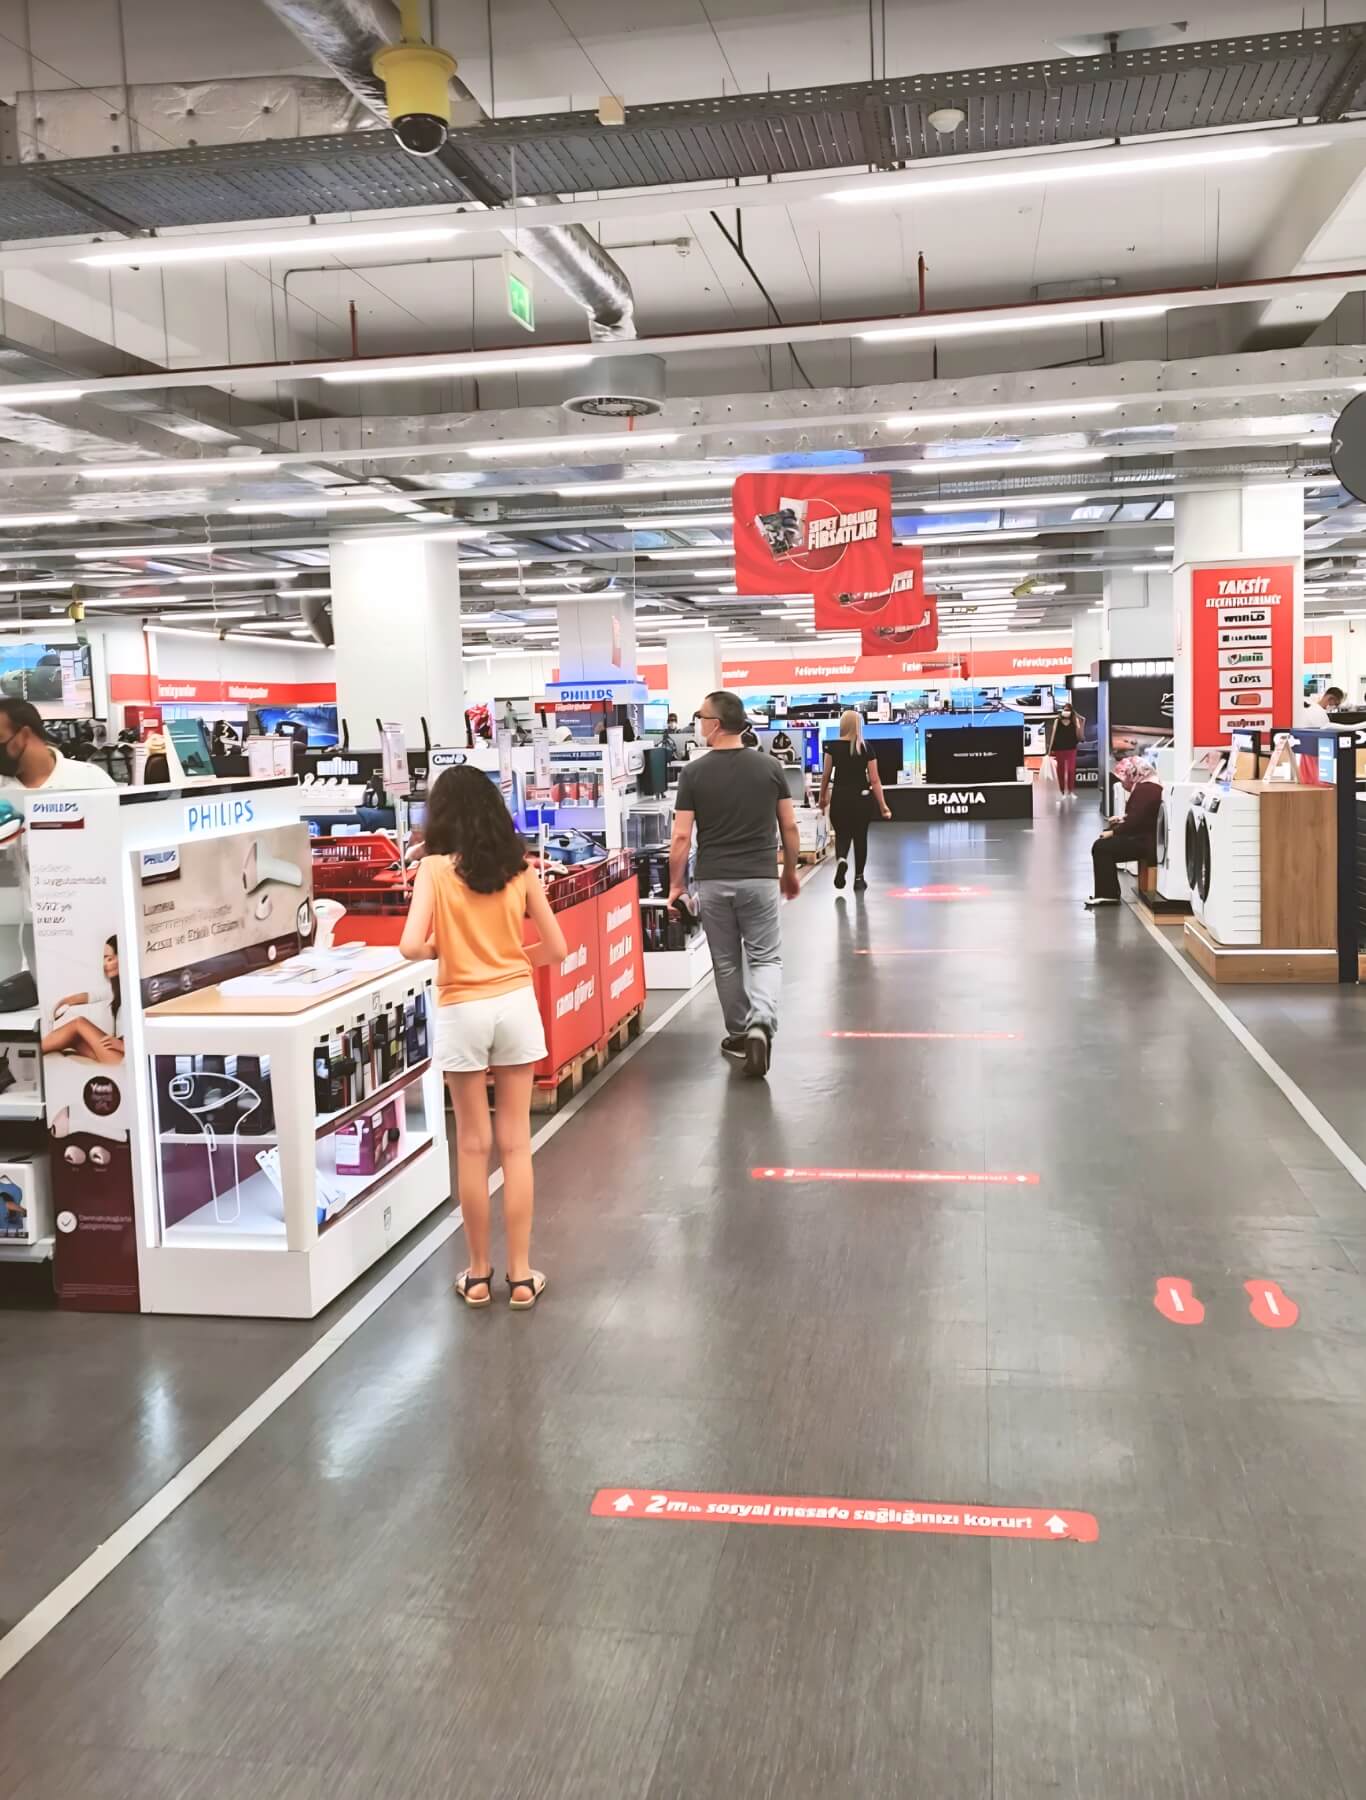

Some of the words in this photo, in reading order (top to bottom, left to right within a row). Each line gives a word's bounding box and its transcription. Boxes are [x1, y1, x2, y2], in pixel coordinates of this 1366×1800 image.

[808, 521, 877, 550] FIRSATLAR
[1218, 576, 1271, 595] TAKSİT
[1111, 661, 1174, 677] SAMSUN
[561, 689, 613, 701] PHILIPS
[928, 791, 986, 805] BRAVIA
[188, 800, 254, 832] PHILIPS
[706, 1502, 771, 1517] sosyal
